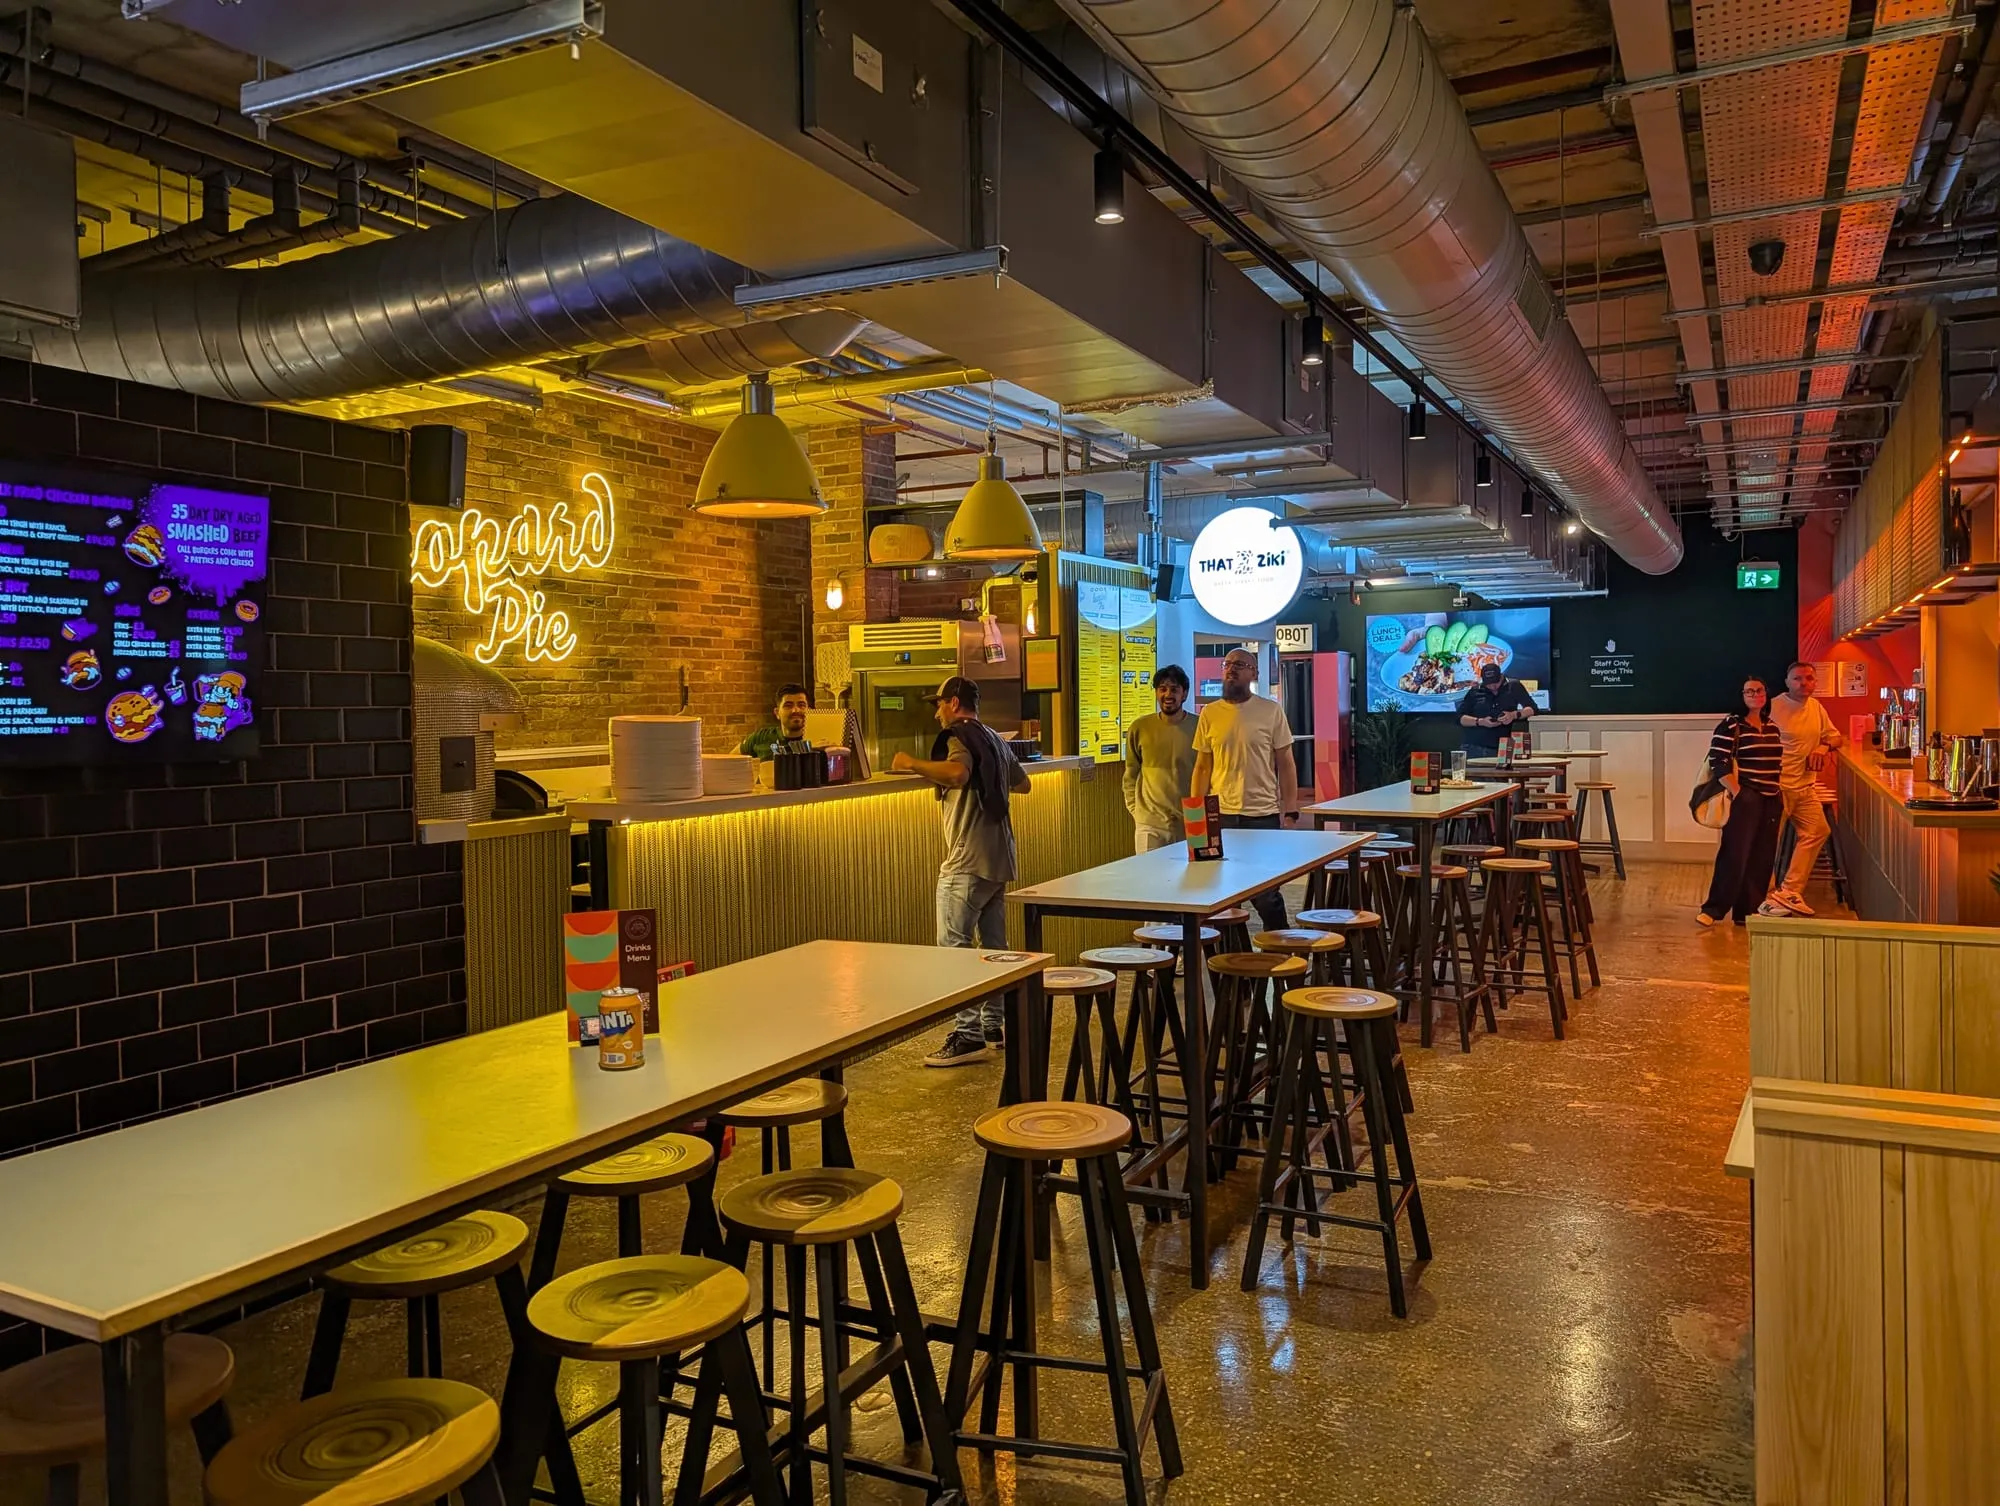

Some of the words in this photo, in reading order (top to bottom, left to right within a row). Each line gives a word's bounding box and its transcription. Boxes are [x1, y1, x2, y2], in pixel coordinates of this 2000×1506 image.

[171, 504, 188, 520] 35
[188, 507, 210, 520] DAY
[213, 508, 234, 522] DRY
[167, 522, 229, 543] SMASHED
[232, 528, 262, 544] BEEF
[410, 472, 615, 614] opard
[192, 546, 218, 556] BURGERS
[238, 549, 254, 559] WITH
[184, 555, 190, 564] 2
[190, 556, 214, 566] PATTIES
[216, 557, 230, 566] AND
[1199, 558, 1234, 573] THAT
[475, 577, 577, 663] Pie
[1276, 627, 1309, 644] OBOT
[1371, 628, 1401, 636] LUNCH
[1373, 634, 1402, 642] DEALS
[1613, 660, 1630, 668] Only
[1591, 668, 1617, 676] Beyond
[624, 944, 652, 952] Drinks
[626, 954, 650, 963] Menu
[600, 1010, 635, 1030] ANTA
